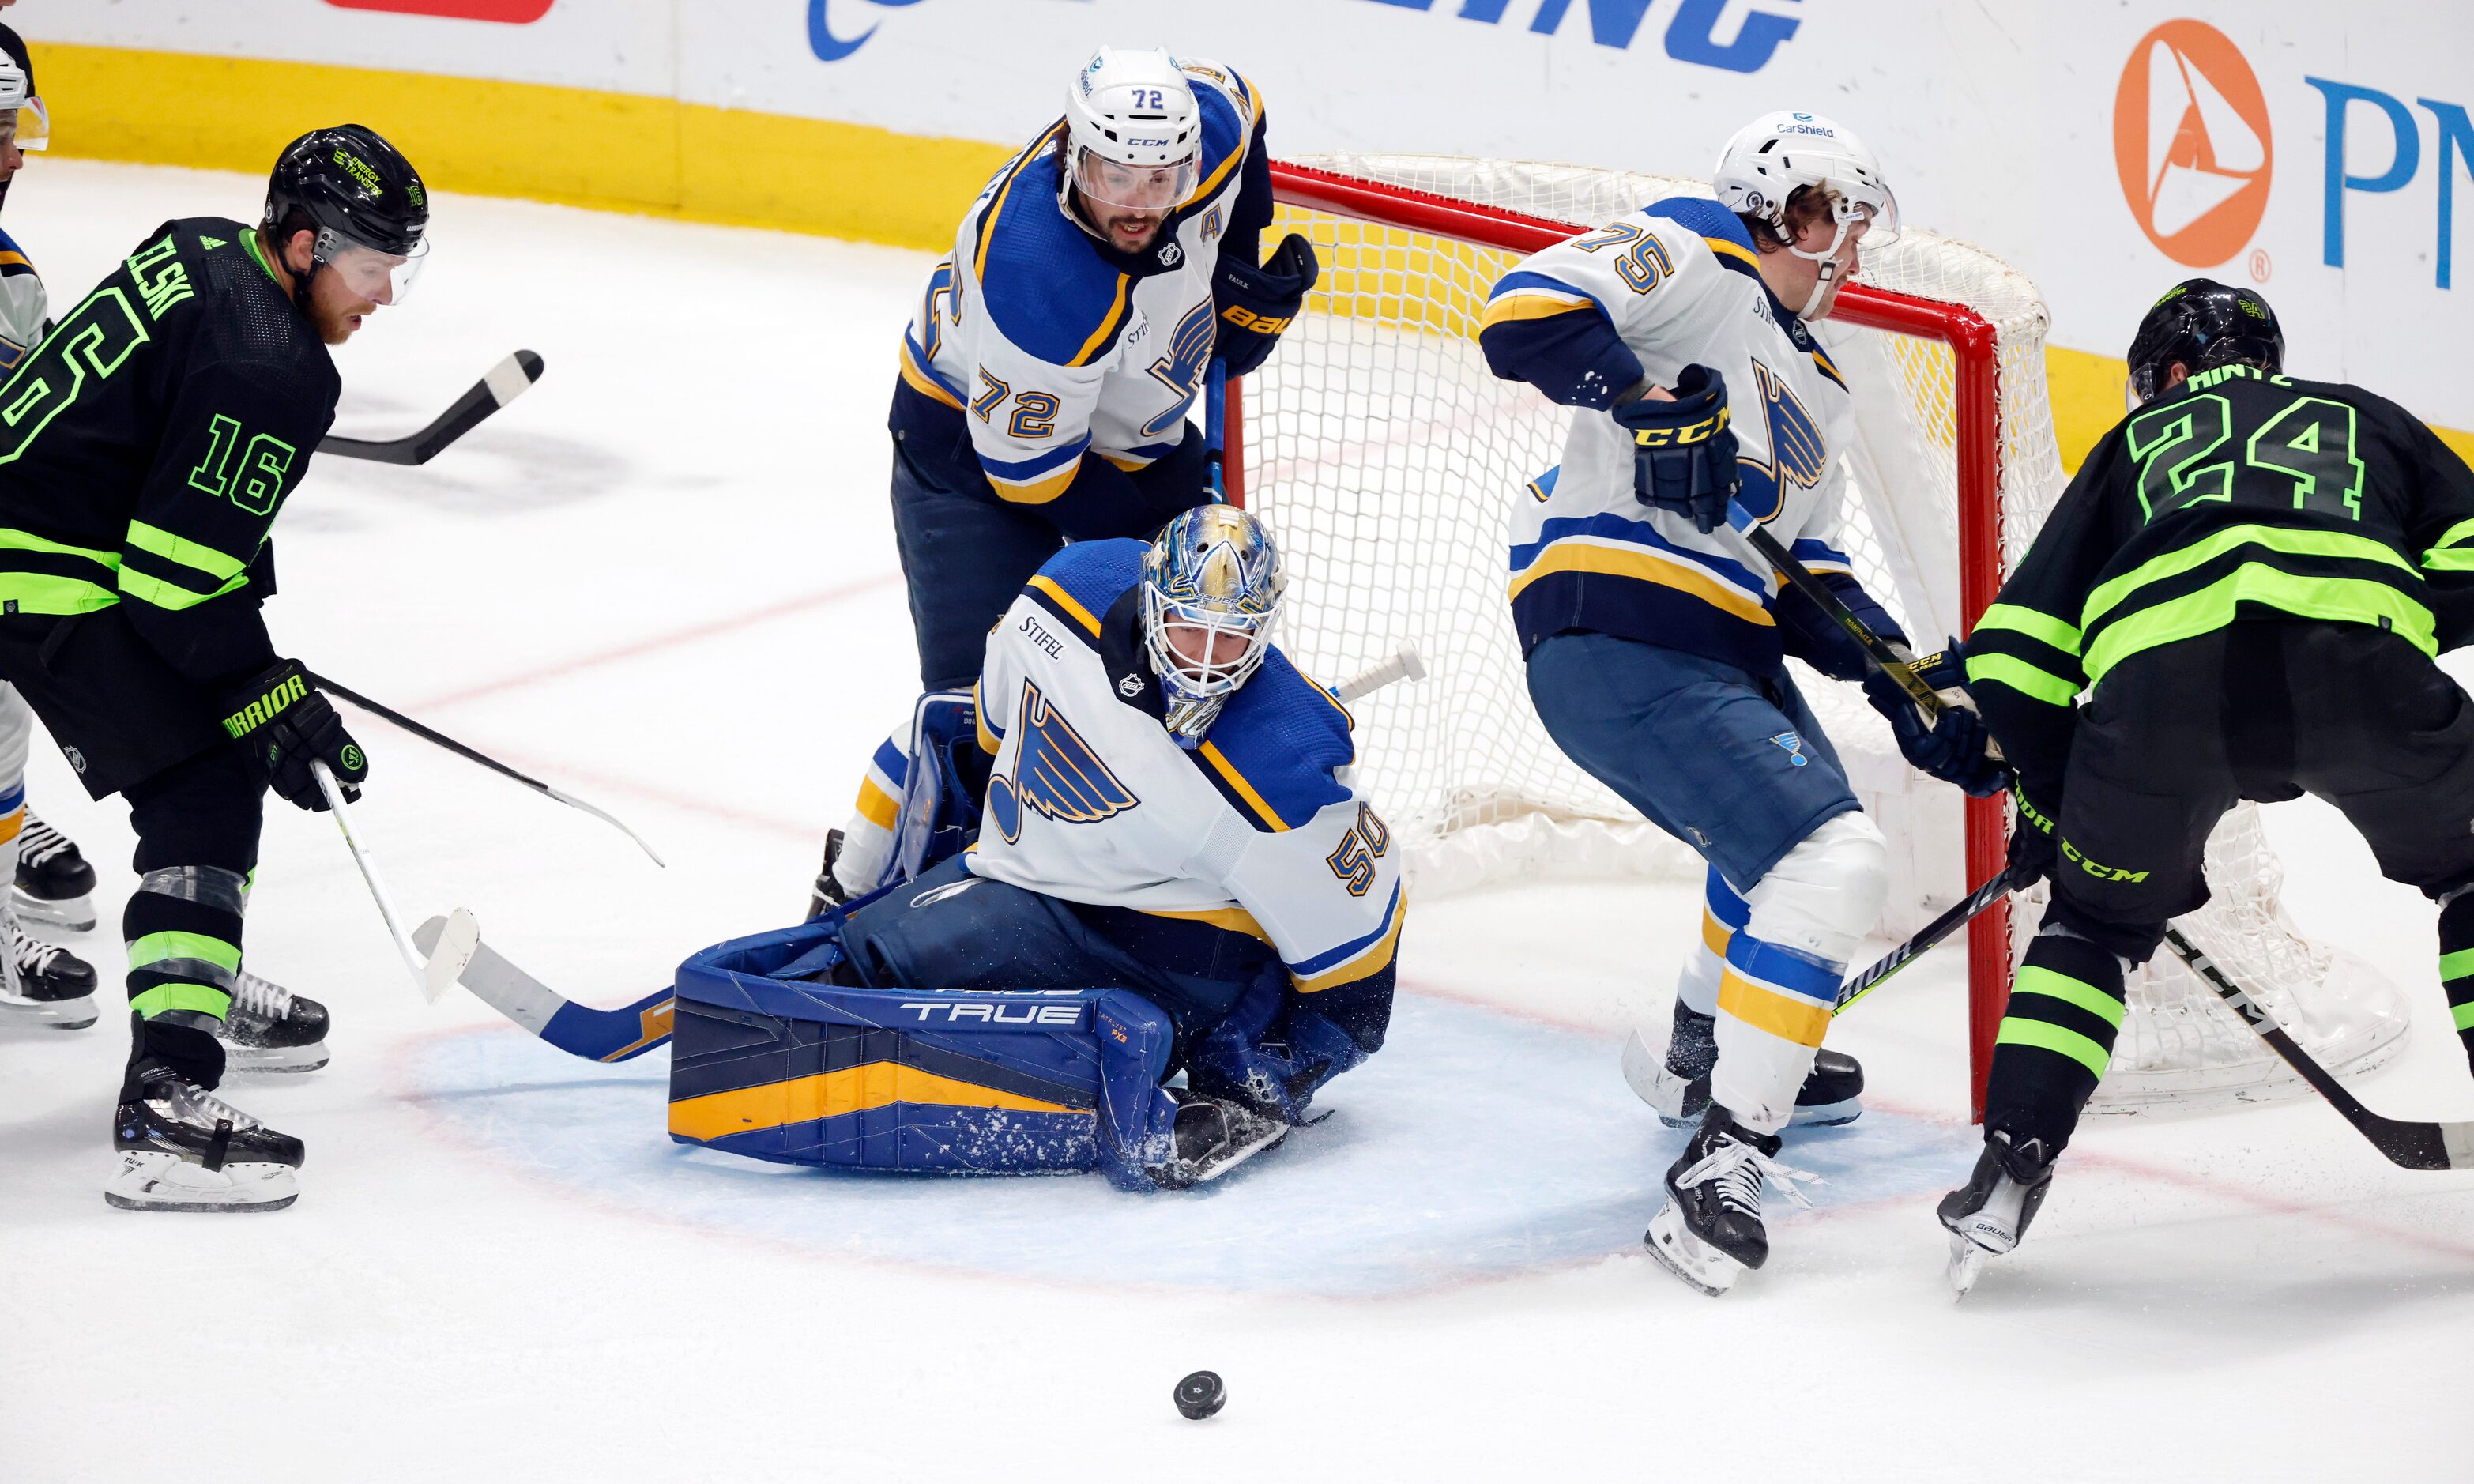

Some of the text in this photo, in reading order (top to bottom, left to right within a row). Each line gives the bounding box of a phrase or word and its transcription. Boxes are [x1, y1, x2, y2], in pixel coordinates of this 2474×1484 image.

[1132, 89, 1163, 109] 72
[1127, 138, 1169, 147] CCM
[1777, 124, 1834, 138] CarShield
[345, 164, 383, 198] TRANSFER
[350, 156, 382, 183] ENERGY
[406, 186, 424, 206] 16
[1200, 203, 1223, 247] A
[1571, 222, 1674, 296] 75
[126, 233, 195, 322] ELSKI
[1229, 273, 1250, 290] FAULK
[2237, 299, 2262, 319] 24
[971, 362, 1060, 439] 72
[188, 413, 296, 516] 16
[2126, 394, 2365, 527] 24
[1019, 616, 1064, 660] STIFEL
[1908, 653, 1942, 669] CCM
[1326, 801, 1390, 896] 50
[2062, 836, 2150, 883] CCM
[899, 1003, 1083, 1025] TRUE
